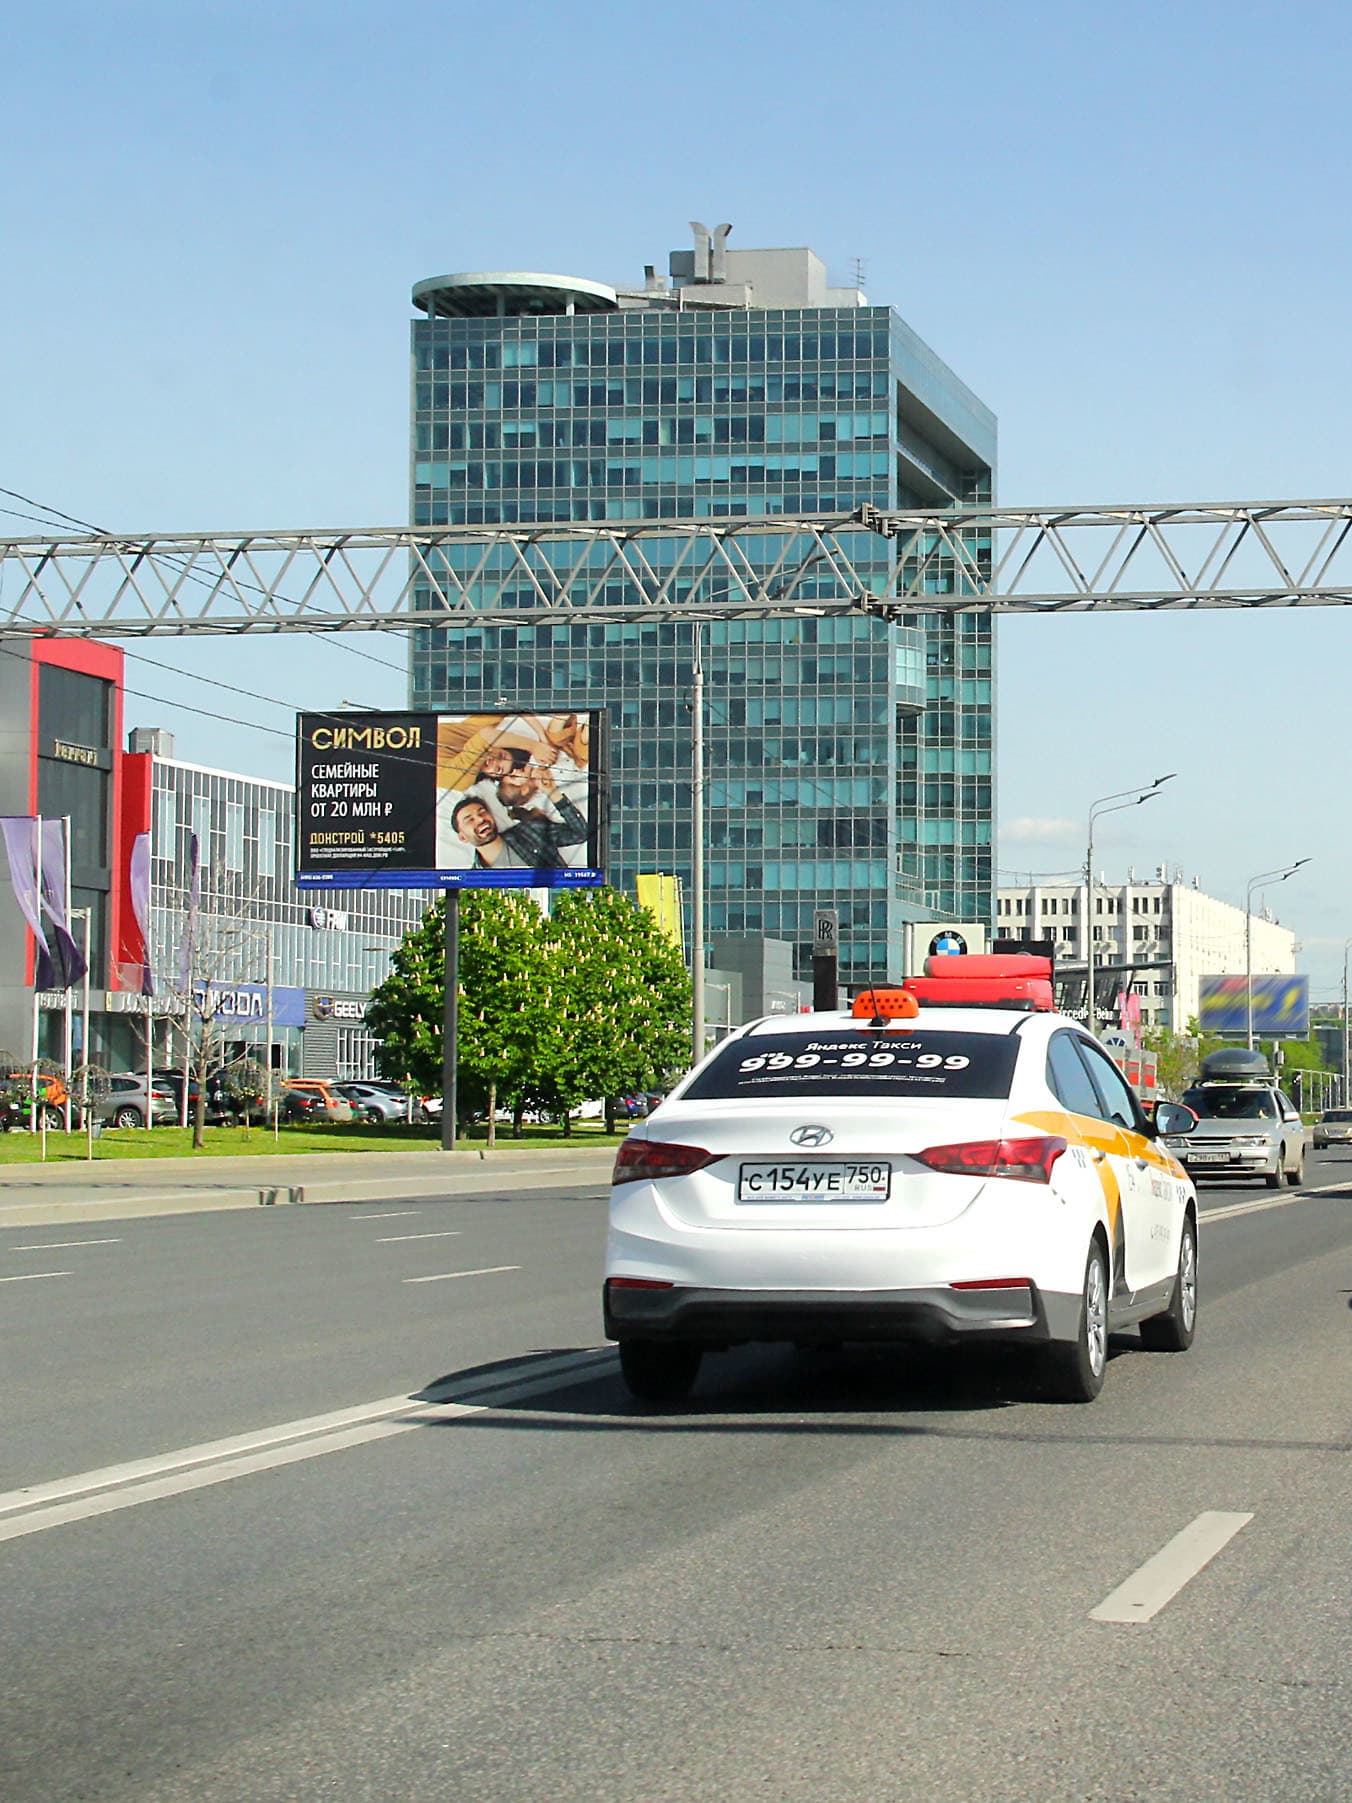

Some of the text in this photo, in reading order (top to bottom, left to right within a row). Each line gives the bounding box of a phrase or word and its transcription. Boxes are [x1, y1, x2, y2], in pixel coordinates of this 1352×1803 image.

[311, 726, 421, 750] СИМВОЛ
[311, 762, 380, 779] СЕМЕЙНЫЕ
[311, 783, 377, 798] КВАРТИРЫ
[311, 802, 327, 817] ОТ
[330, 801, 348, 817] 20
[352, 802, 381, 817] МЛН
[309, 829, 365, 845] ДОНСТРОЙ
[334, 1000, 367, 1018] GEELY
[805, 1041, 922, 1051] Яндекс Такси
[738, 1052, 970, 1073] 999-99-99
[847, 1166, 882, 1184] 750
